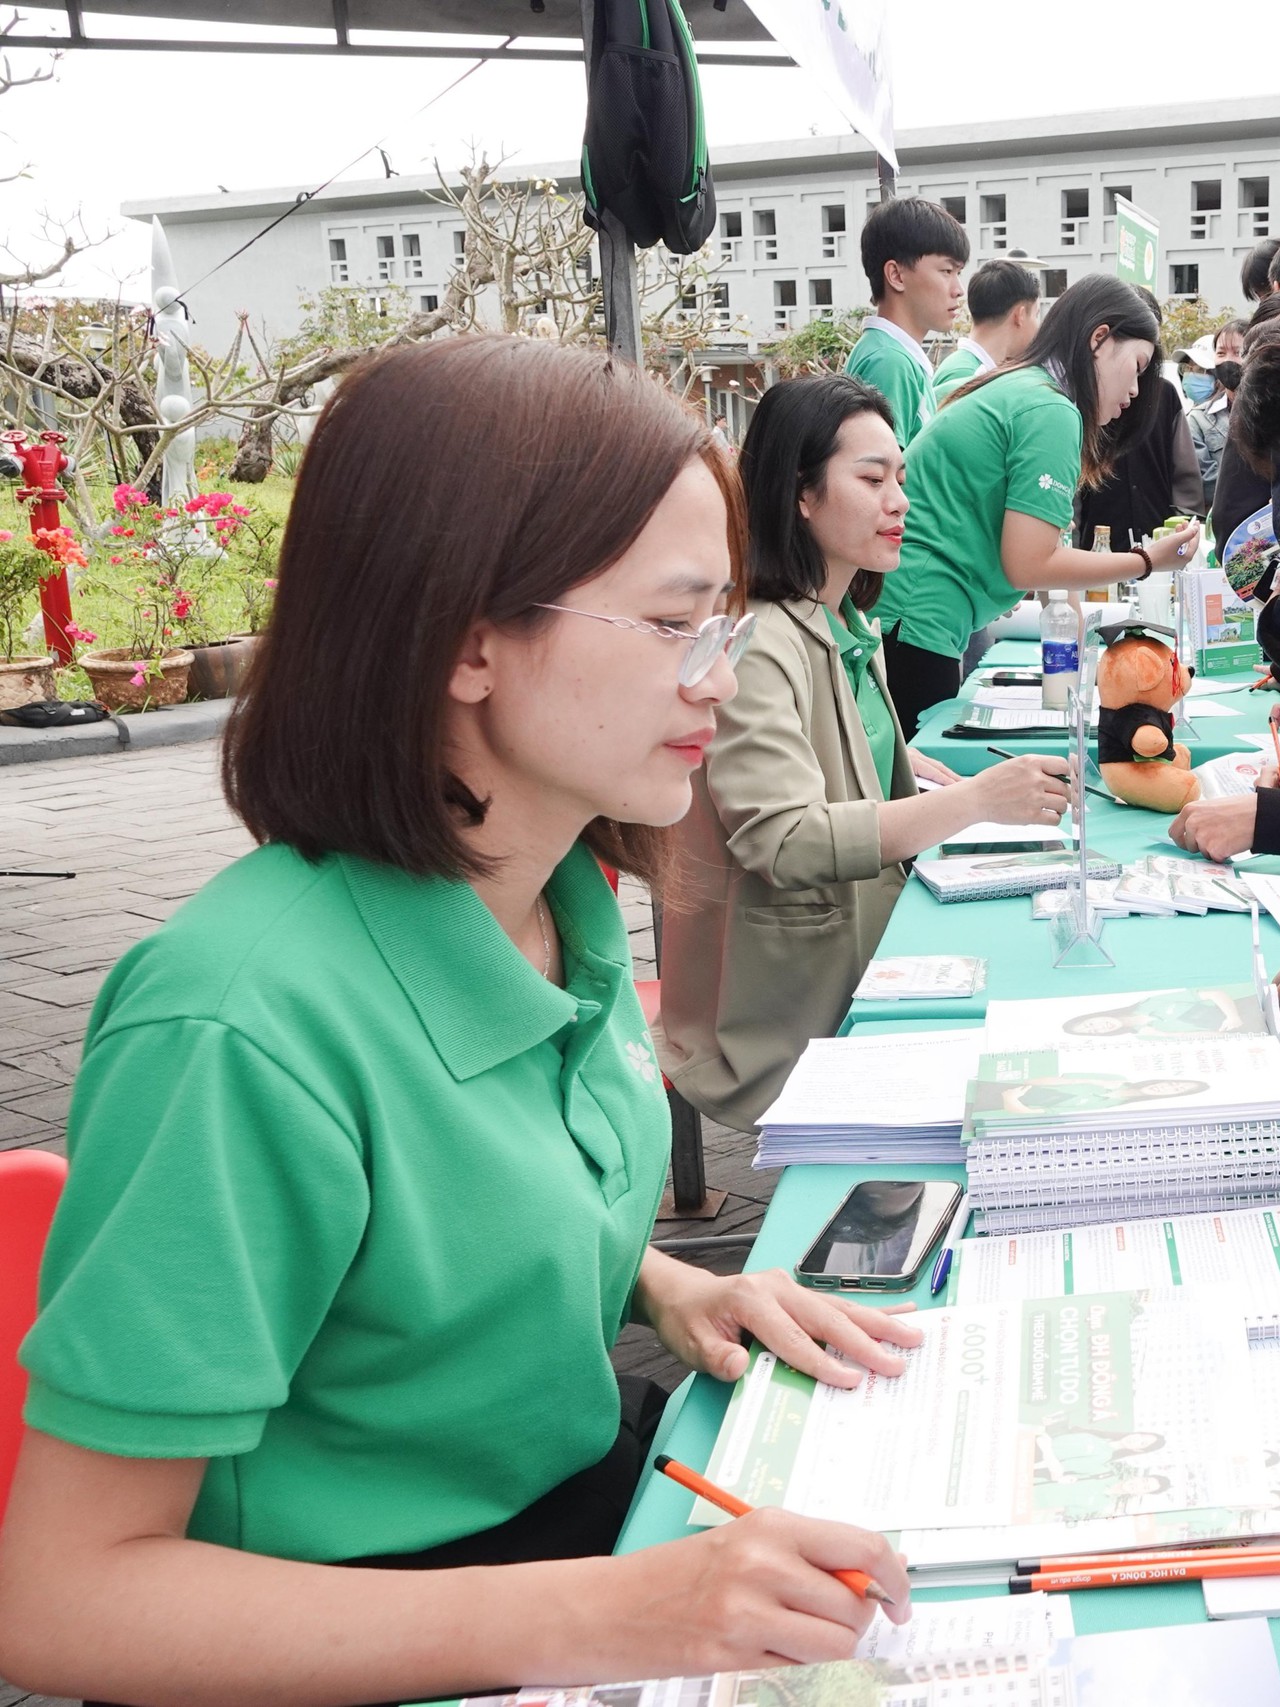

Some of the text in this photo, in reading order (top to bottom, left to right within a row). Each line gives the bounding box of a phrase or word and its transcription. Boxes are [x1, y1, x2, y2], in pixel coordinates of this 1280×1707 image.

[1033, 1313, 1046, 1338] THEO
[1032, 1339, 1050, 1363] ĐUỔI
[1053, 1306, 1083, 1405] CHỌN TỰ DO
[1090, 1334, 1111, 1358] ĐH
[1032, 1387, 1048, 1402] MÊ
[1091, 1360, 1117, 1410] ĐÔNG
[1092, 1410, 1121, 1424] Á
